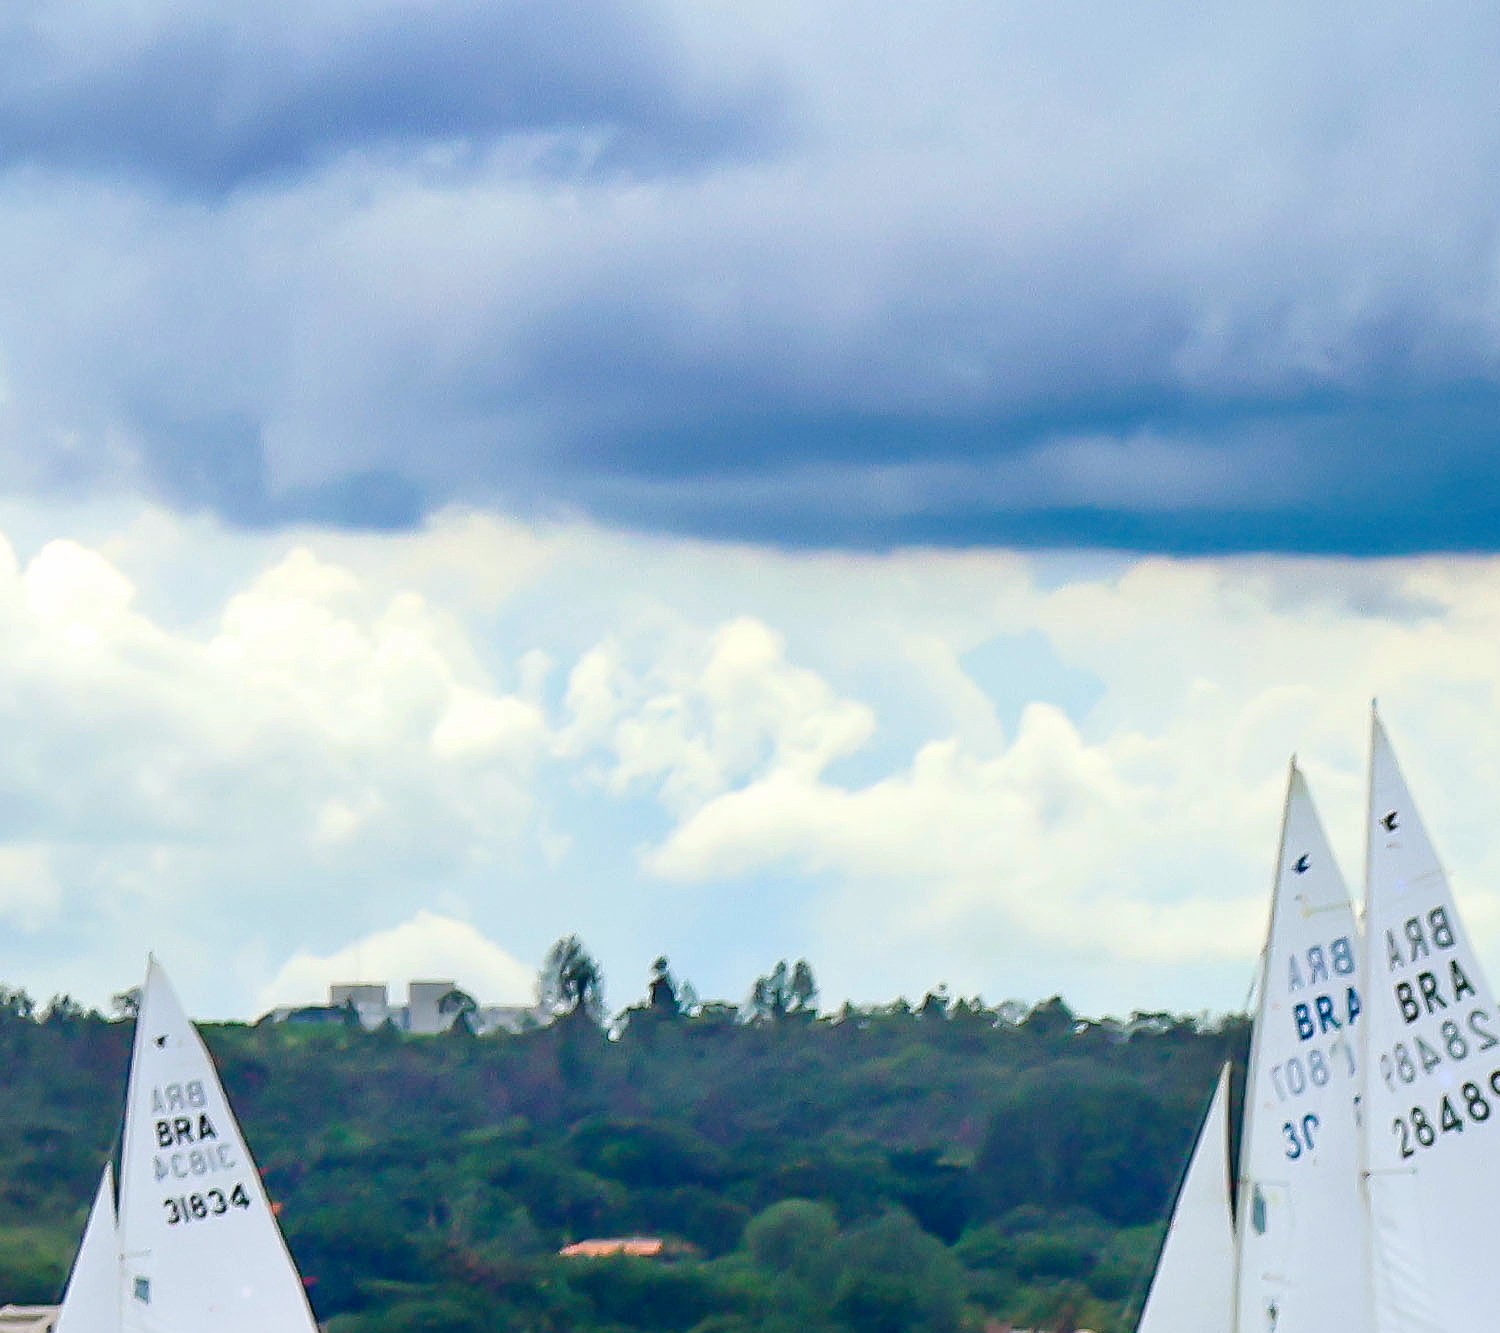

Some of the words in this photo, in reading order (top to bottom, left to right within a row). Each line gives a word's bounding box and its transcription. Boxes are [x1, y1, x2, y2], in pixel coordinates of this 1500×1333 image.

[1293, 986, 1361, 1041] BRA
[1395, 959, 1476, 1024] BRA
[156, 1113, 217, 1147] BRA
[163, 1183, 250, 1225] 31834
